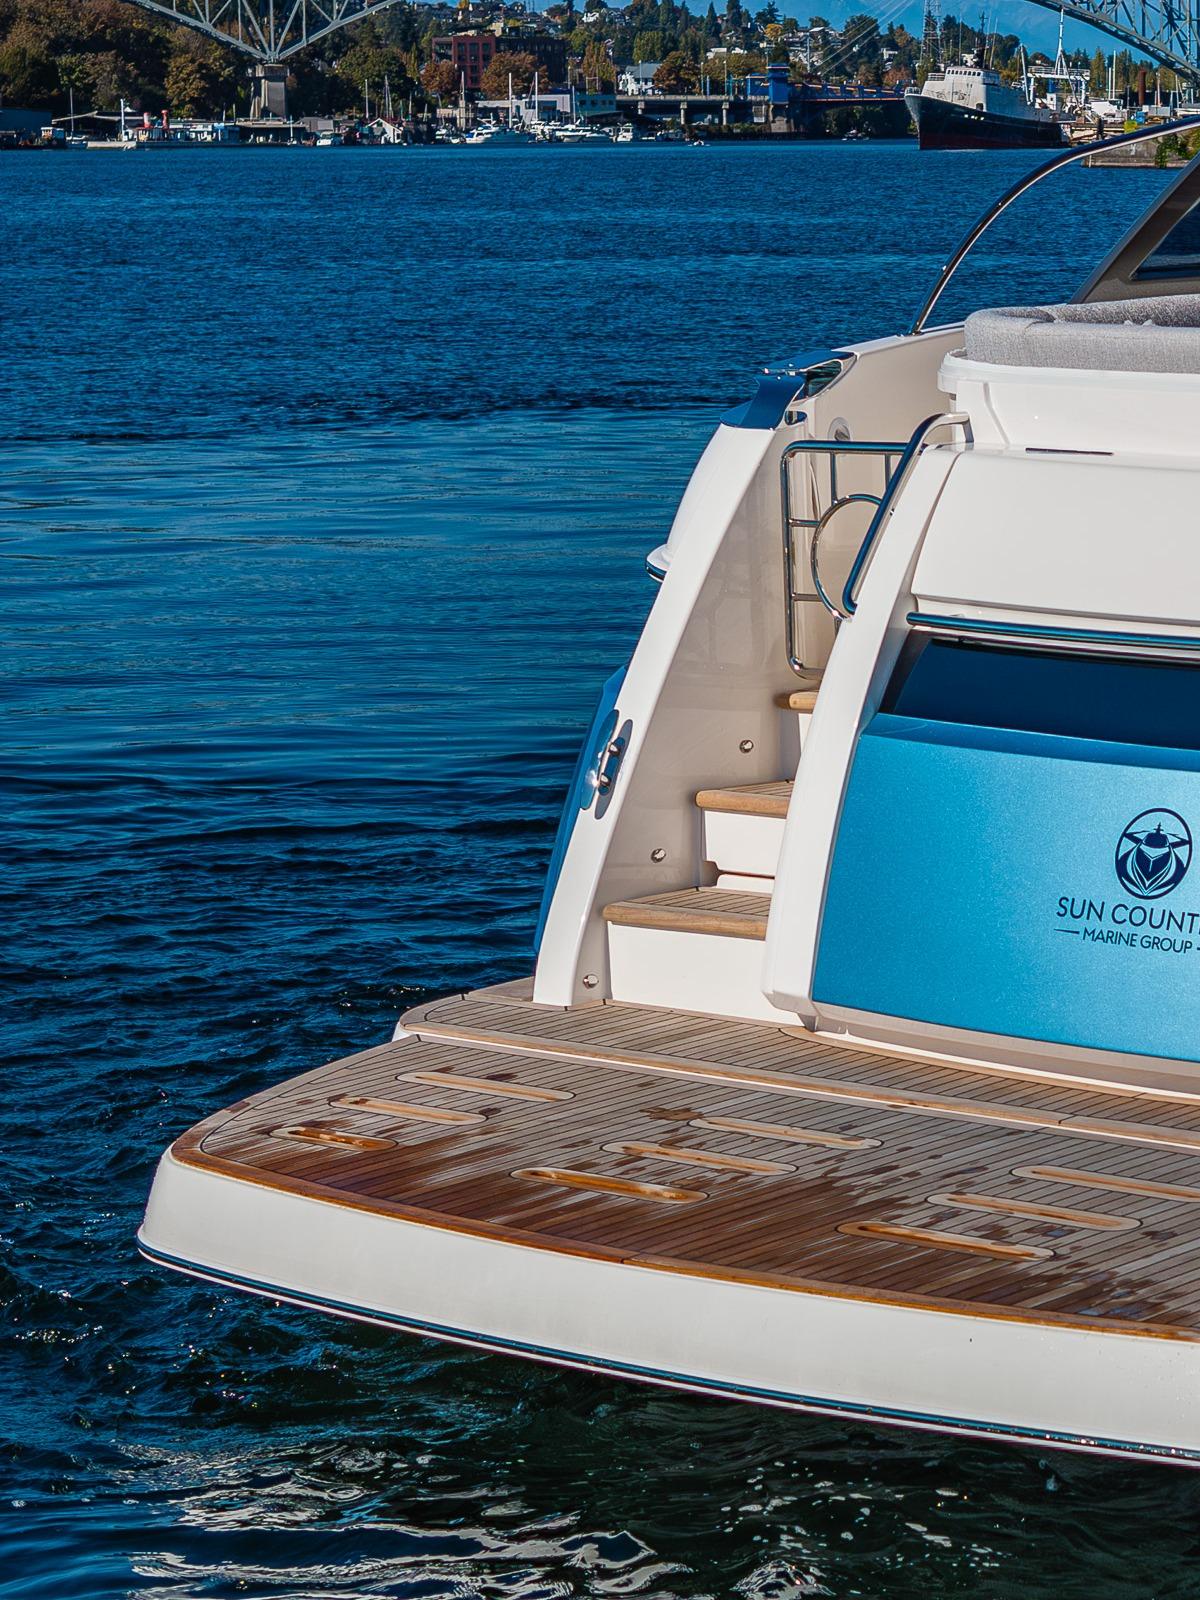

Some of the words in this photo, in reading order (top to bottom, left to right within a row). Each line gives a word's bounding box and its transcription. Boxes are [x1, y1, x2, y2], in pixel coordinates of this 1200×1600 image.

[1056, 896, 1105, 922] SUN
[1082, 926, 1138, 948] MARINE
[1140, 934, 1193, 954] GROUP
